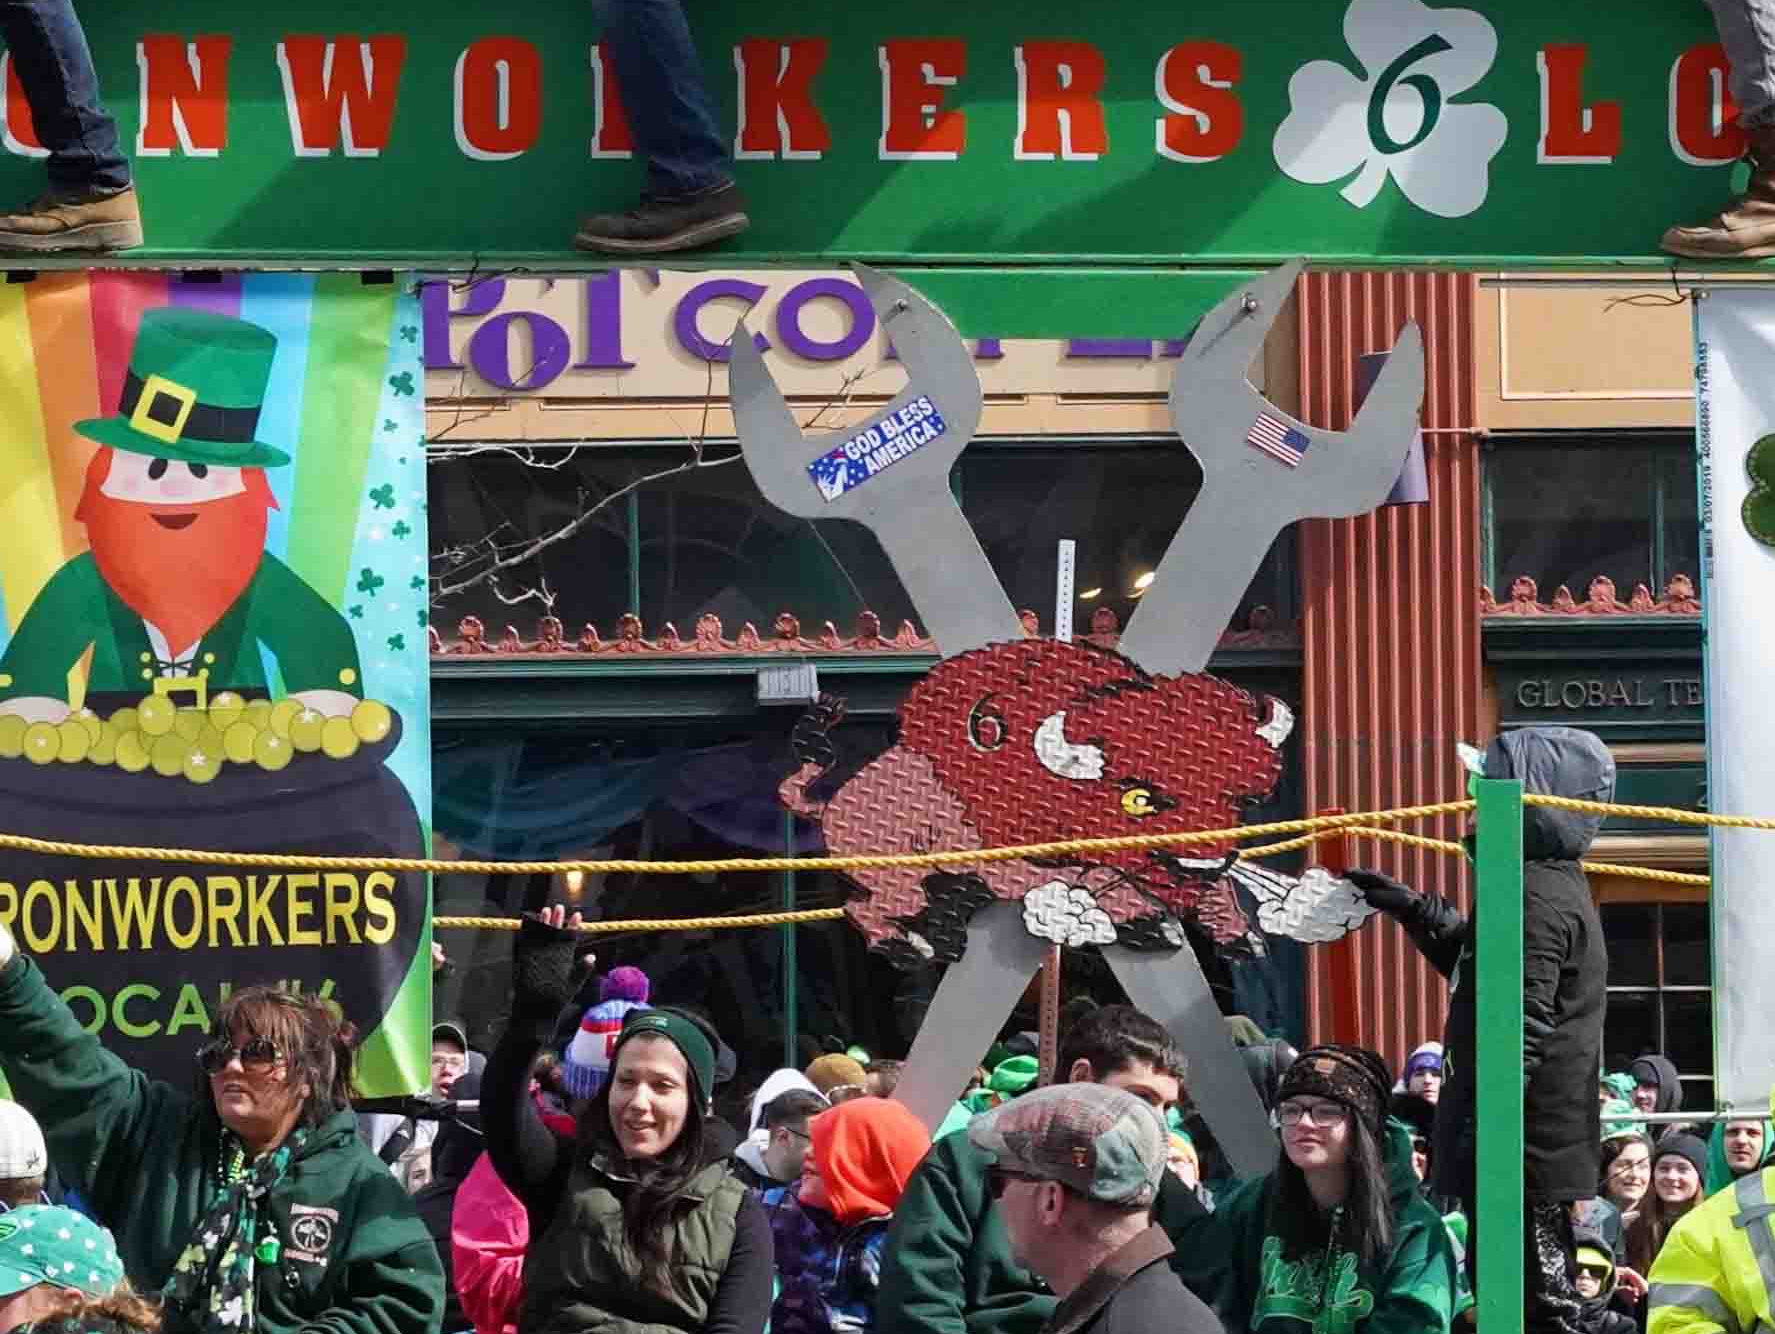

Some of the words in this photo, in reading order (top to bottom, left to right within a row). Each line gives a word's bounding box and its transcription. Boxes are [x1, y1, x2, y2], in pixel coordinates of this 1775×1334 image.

[1366, 33, 1455, 156] 6
[844, 428, 882, 461] GOD
[879, 396, 934, 440] BLESS
[863, 420, 939, 477] AMERICA
[1517, 678, 1655, 709] GLOBAL
[1662, 678, 1704, 707] TE
[967, 698, 1005, 754] 6
